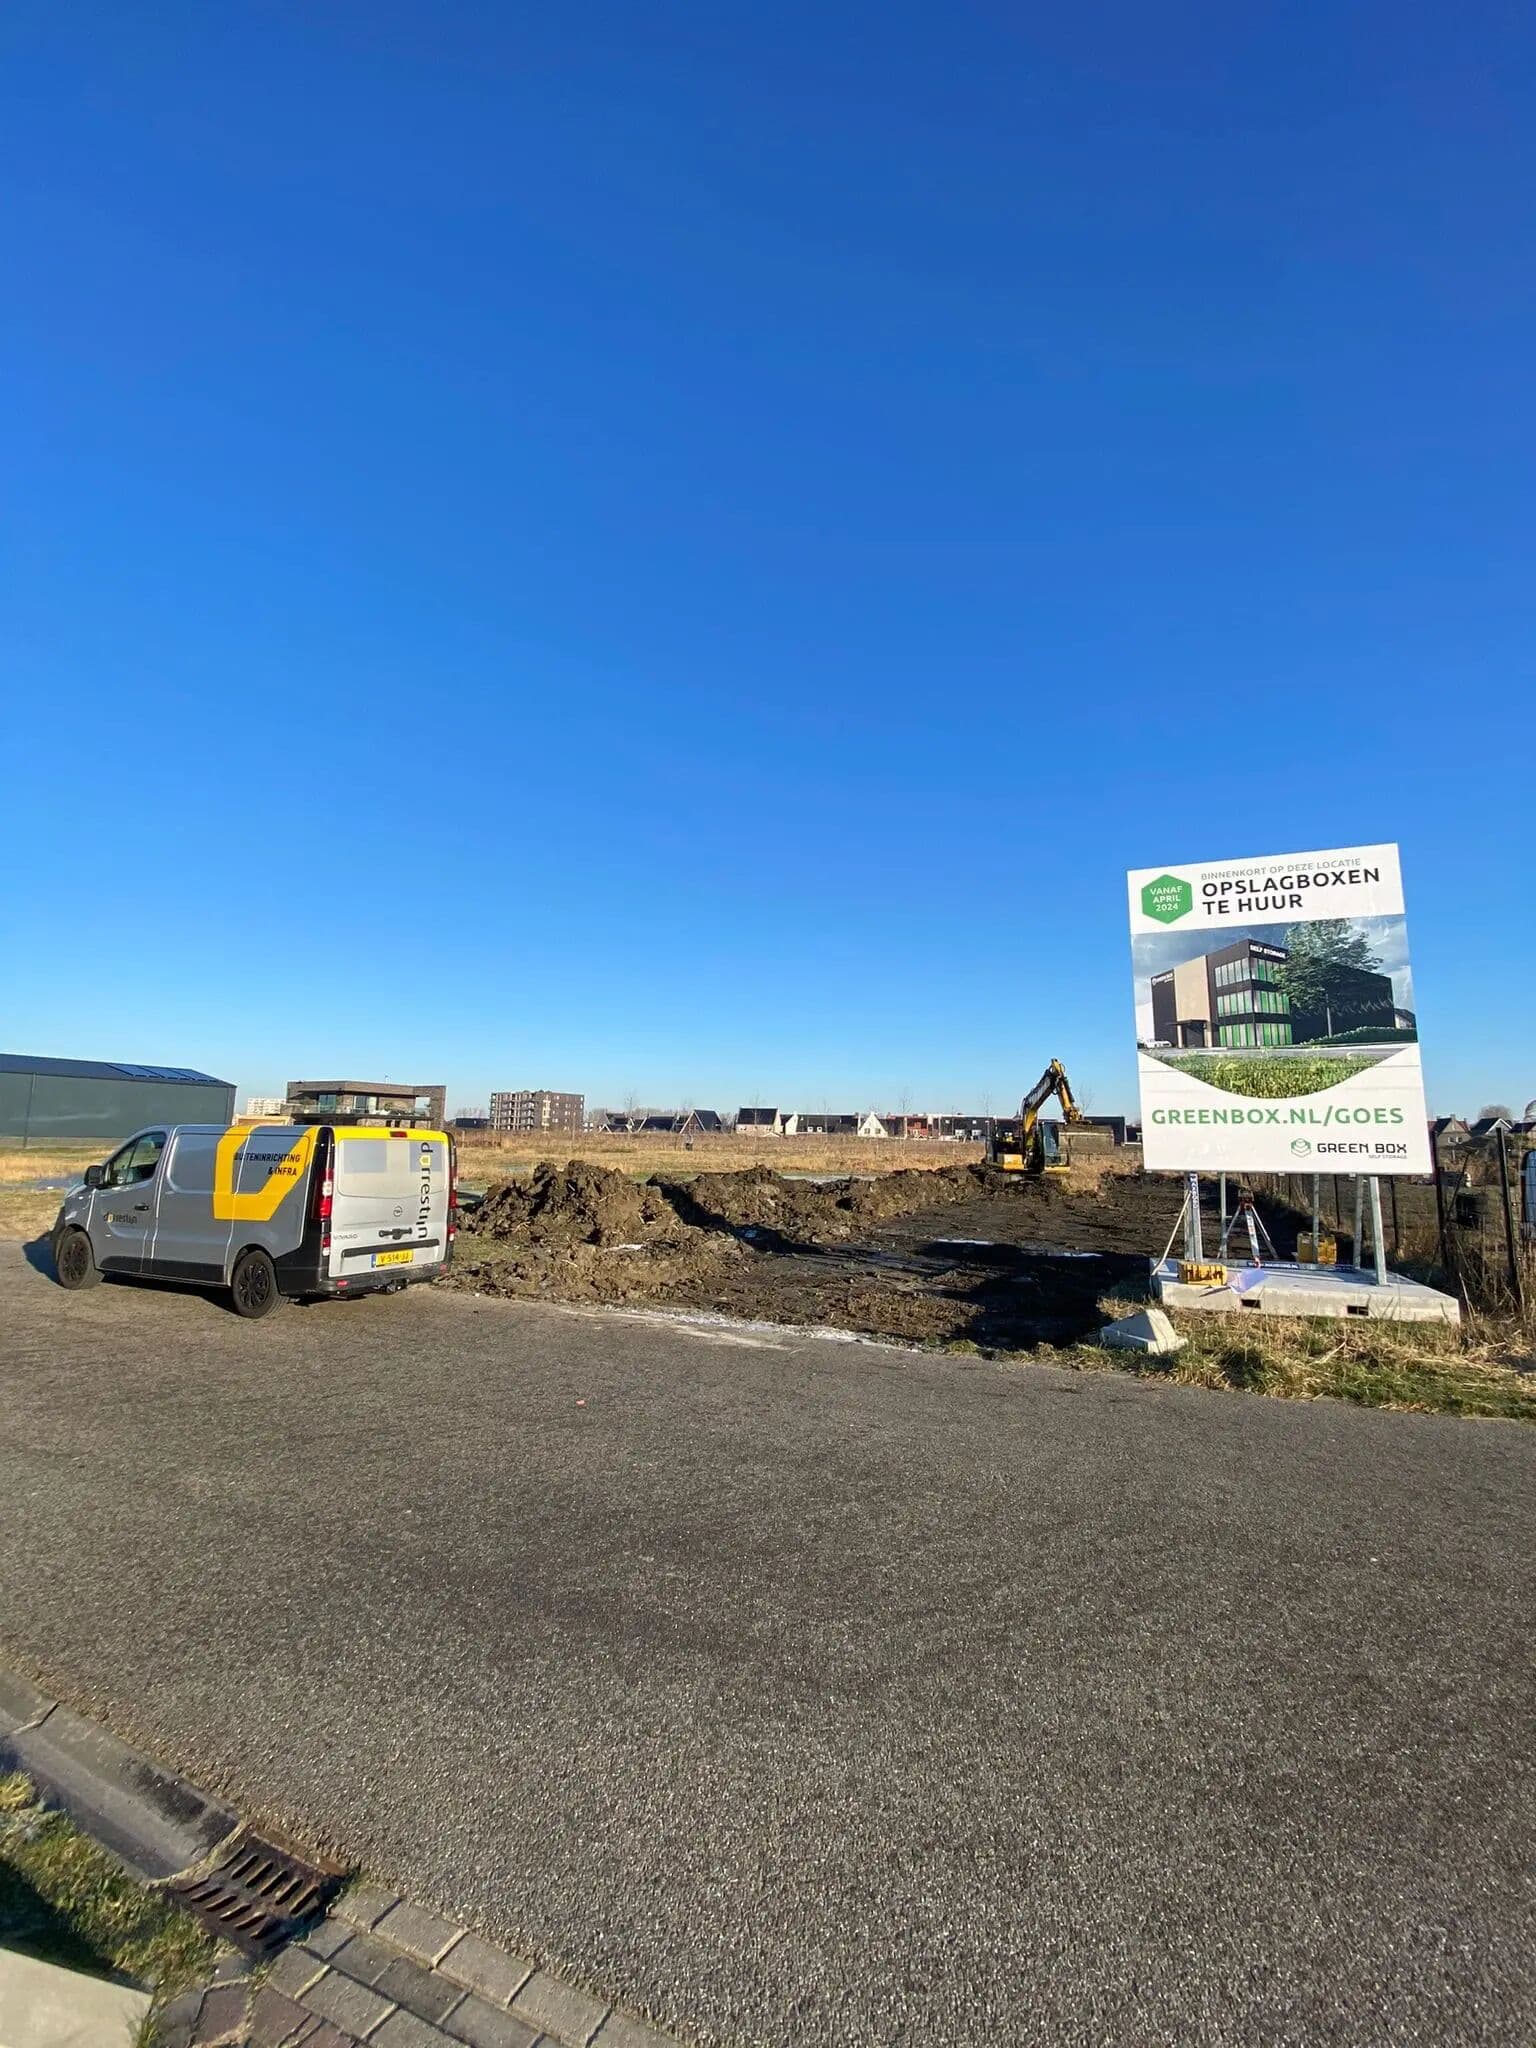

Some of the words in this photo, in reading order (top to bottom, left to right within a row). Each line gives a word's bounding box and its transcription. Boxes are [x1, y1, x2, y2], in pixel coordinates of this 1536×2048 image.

[1201, 867, 1267, 880] BINNENKORT
[1270, 864, 1284, 874] OP
[1288, 862, 1313, 872] DEZE
[1317, 858, 1361, 869] LOCATIE
[1202, 867, 1380, 897] OPSLAGBOXEN
[1149, 885, 1183, 895] VANAF
[1152, 895, 1182, 904] APRIL
[1202, 899, 1230, 915] TE
[1238, 894, 1304, 913] HUUR
[1155, 903, 1179, 912] 2024
[1152, 1105, 1404, 1127] GREENBOX.NL/GOES
[1317, 1143, 1369, 1153] GREEN
[1375, 1143, 1407, 1153] BOX
[274, 1167, 297, 1176] INFRA
